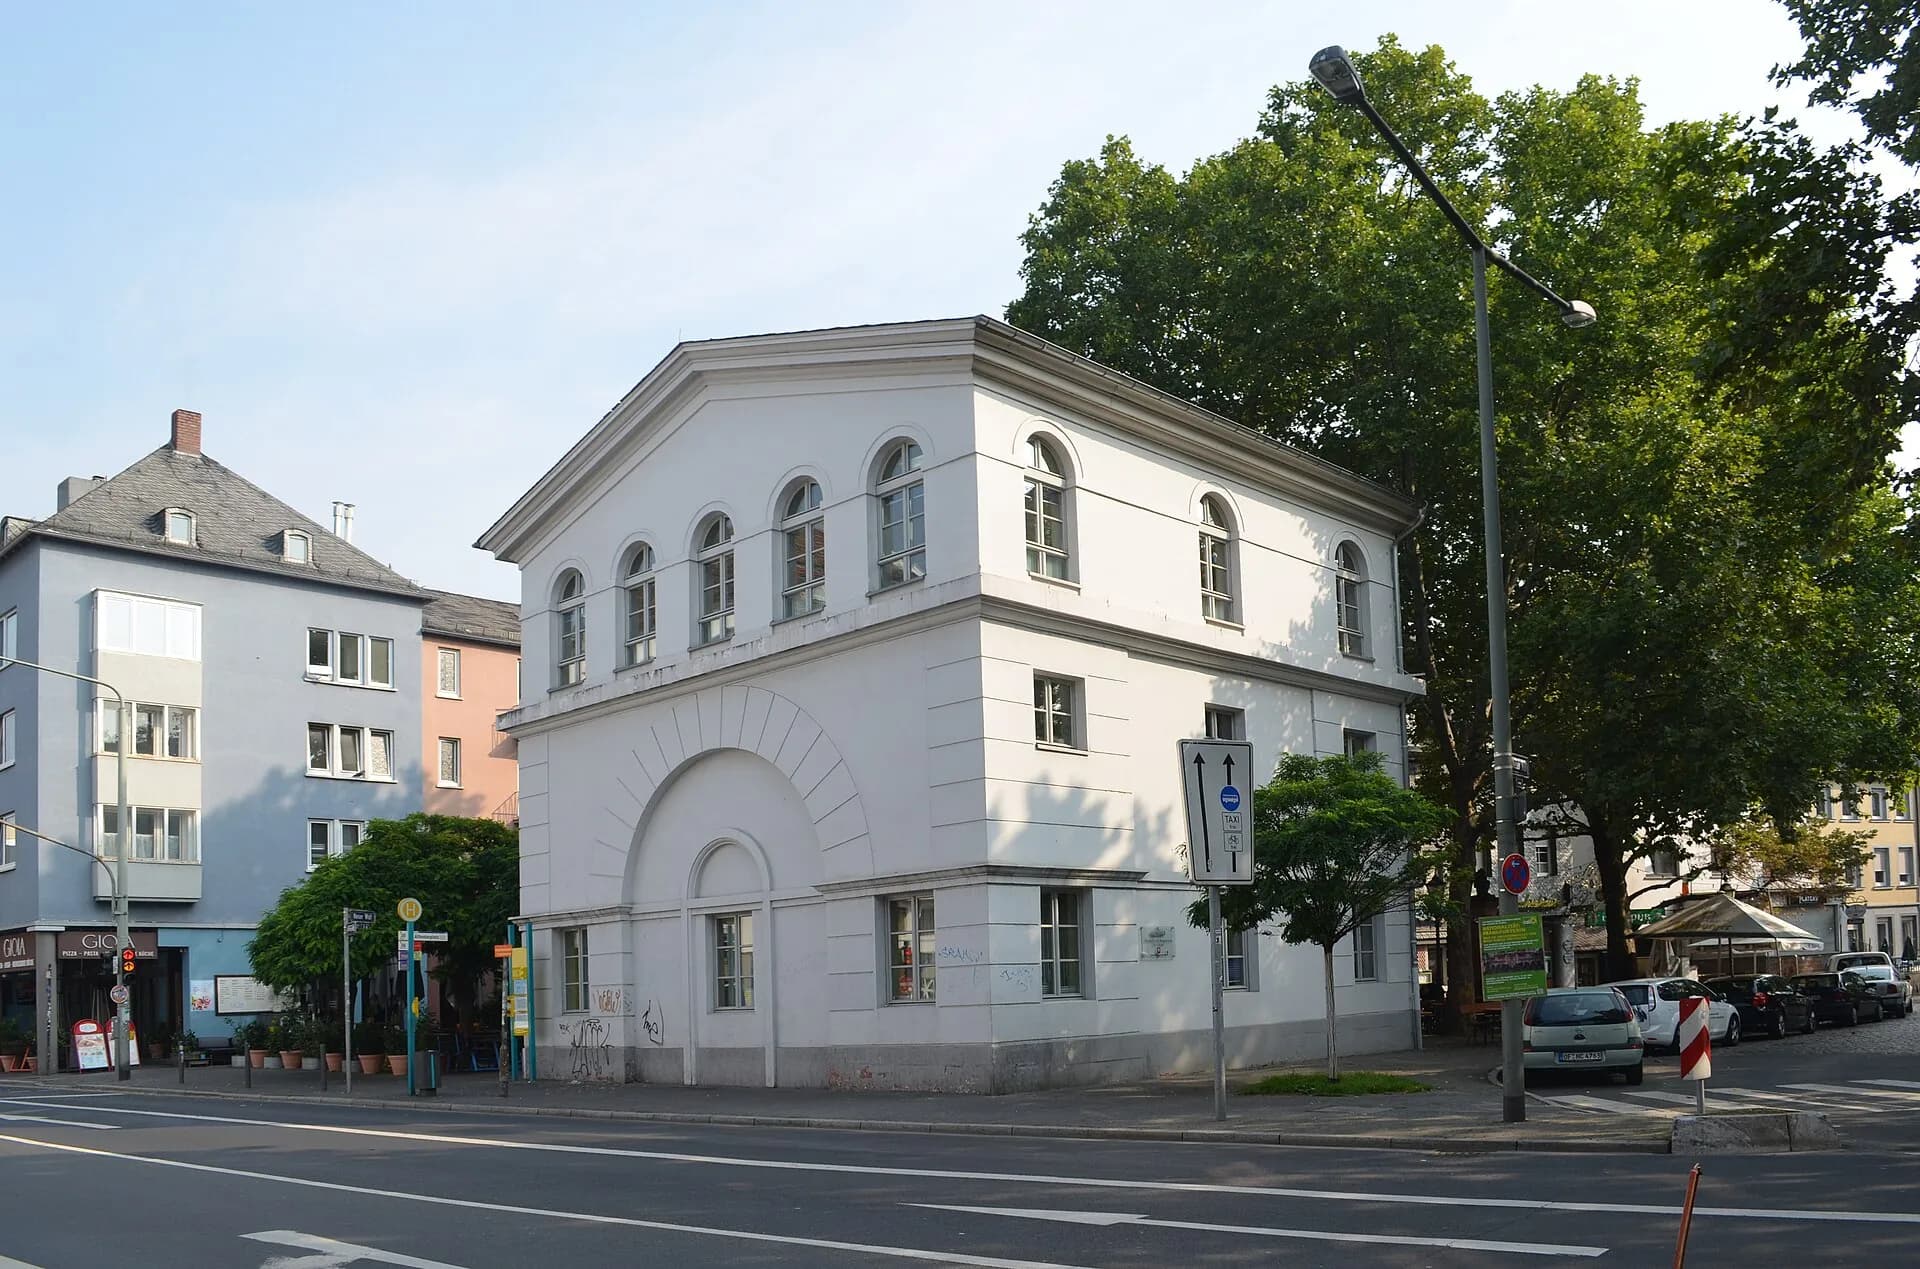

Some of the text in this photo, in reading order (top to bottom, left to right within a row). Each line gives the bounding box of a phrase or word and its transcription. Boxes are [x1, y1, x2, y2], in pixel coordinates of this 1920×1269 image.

[1224, 815, 1240, 823] TAXI
[406, 902, 416, 917] H
[82, 934, 136, 949] GIOA
